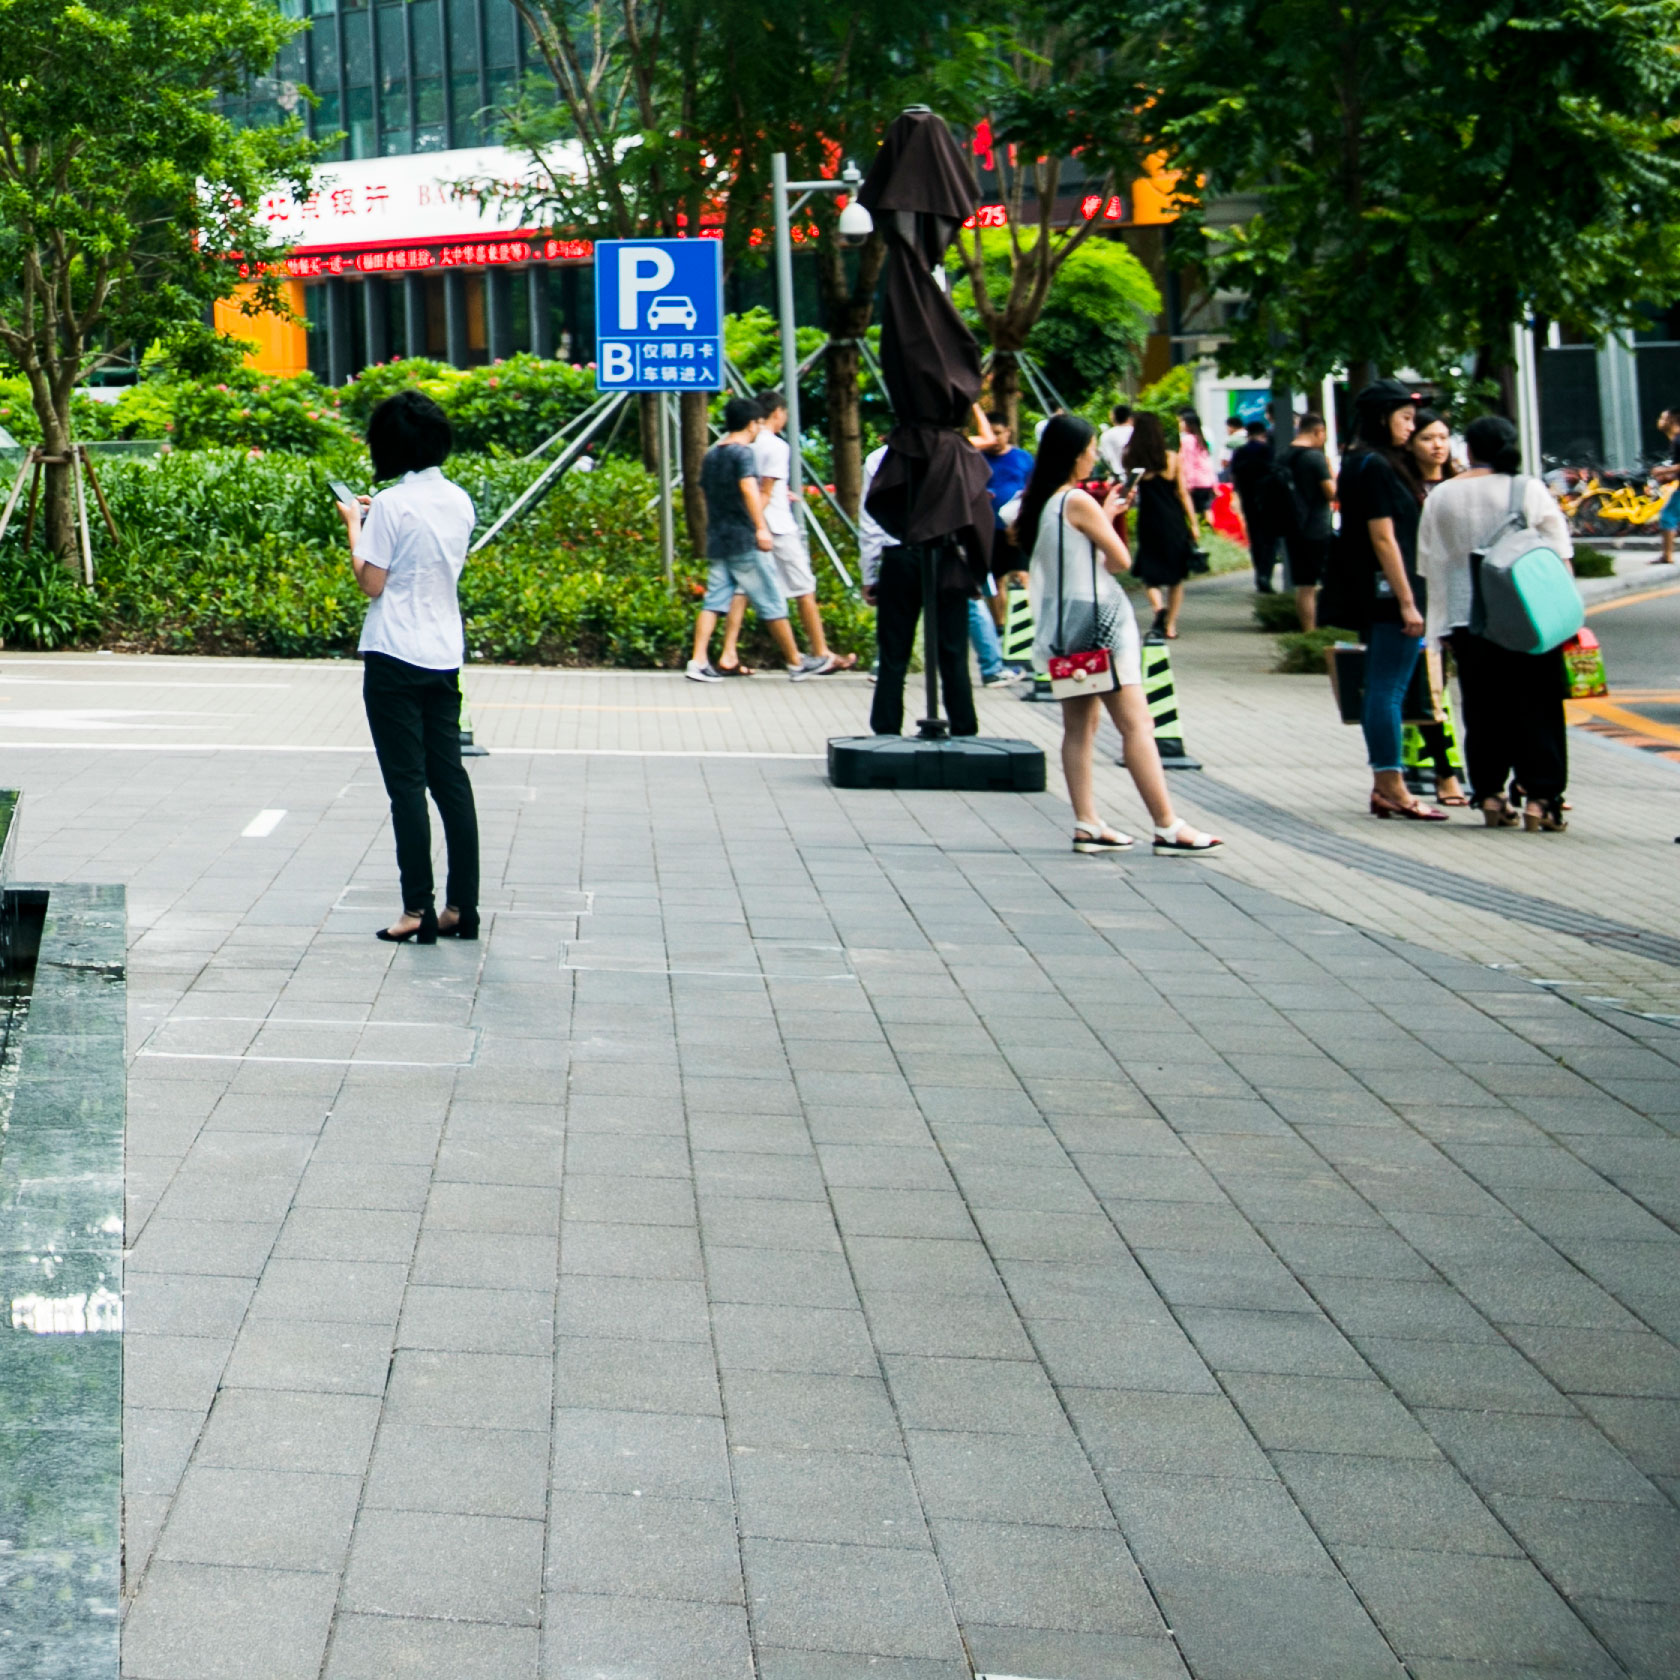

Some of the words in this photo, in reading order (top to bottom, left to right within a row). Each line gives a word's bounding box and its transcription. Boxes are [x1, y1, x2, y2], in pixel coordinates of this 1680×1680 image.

[267, 185, 390, 221] 北京银行
[618, 247, 675, 330] P
[602, 343, 634, 382] B
[643, 343, 714, 359] 仅限月卡
[643, 367, 715, 382] 车辆进入
